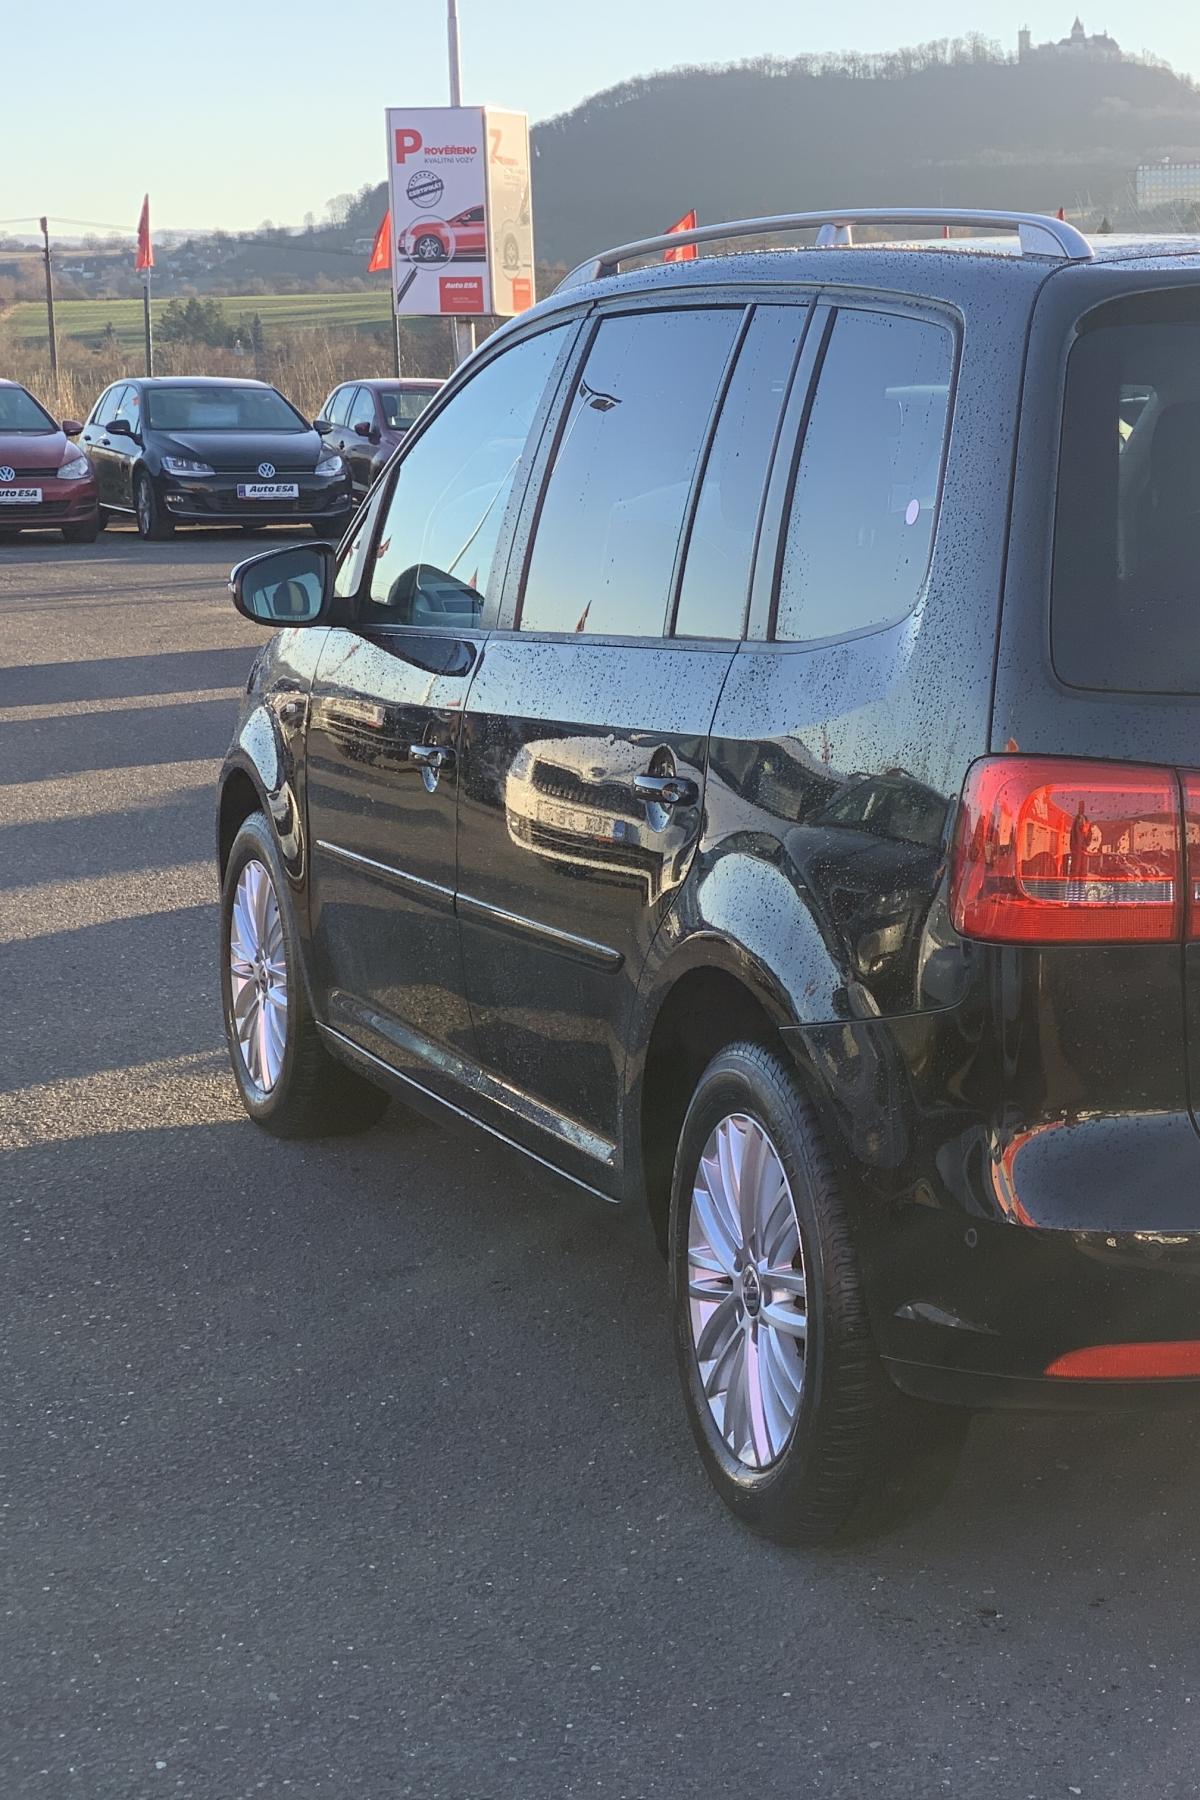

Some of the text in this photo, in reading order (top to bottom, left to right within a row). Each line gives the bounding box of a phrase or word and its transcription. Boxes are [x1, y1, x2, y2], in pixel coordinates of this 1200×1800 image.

[17, 489, 38, 497] ESA
[250, 485, 294, 493] Auto ESA
